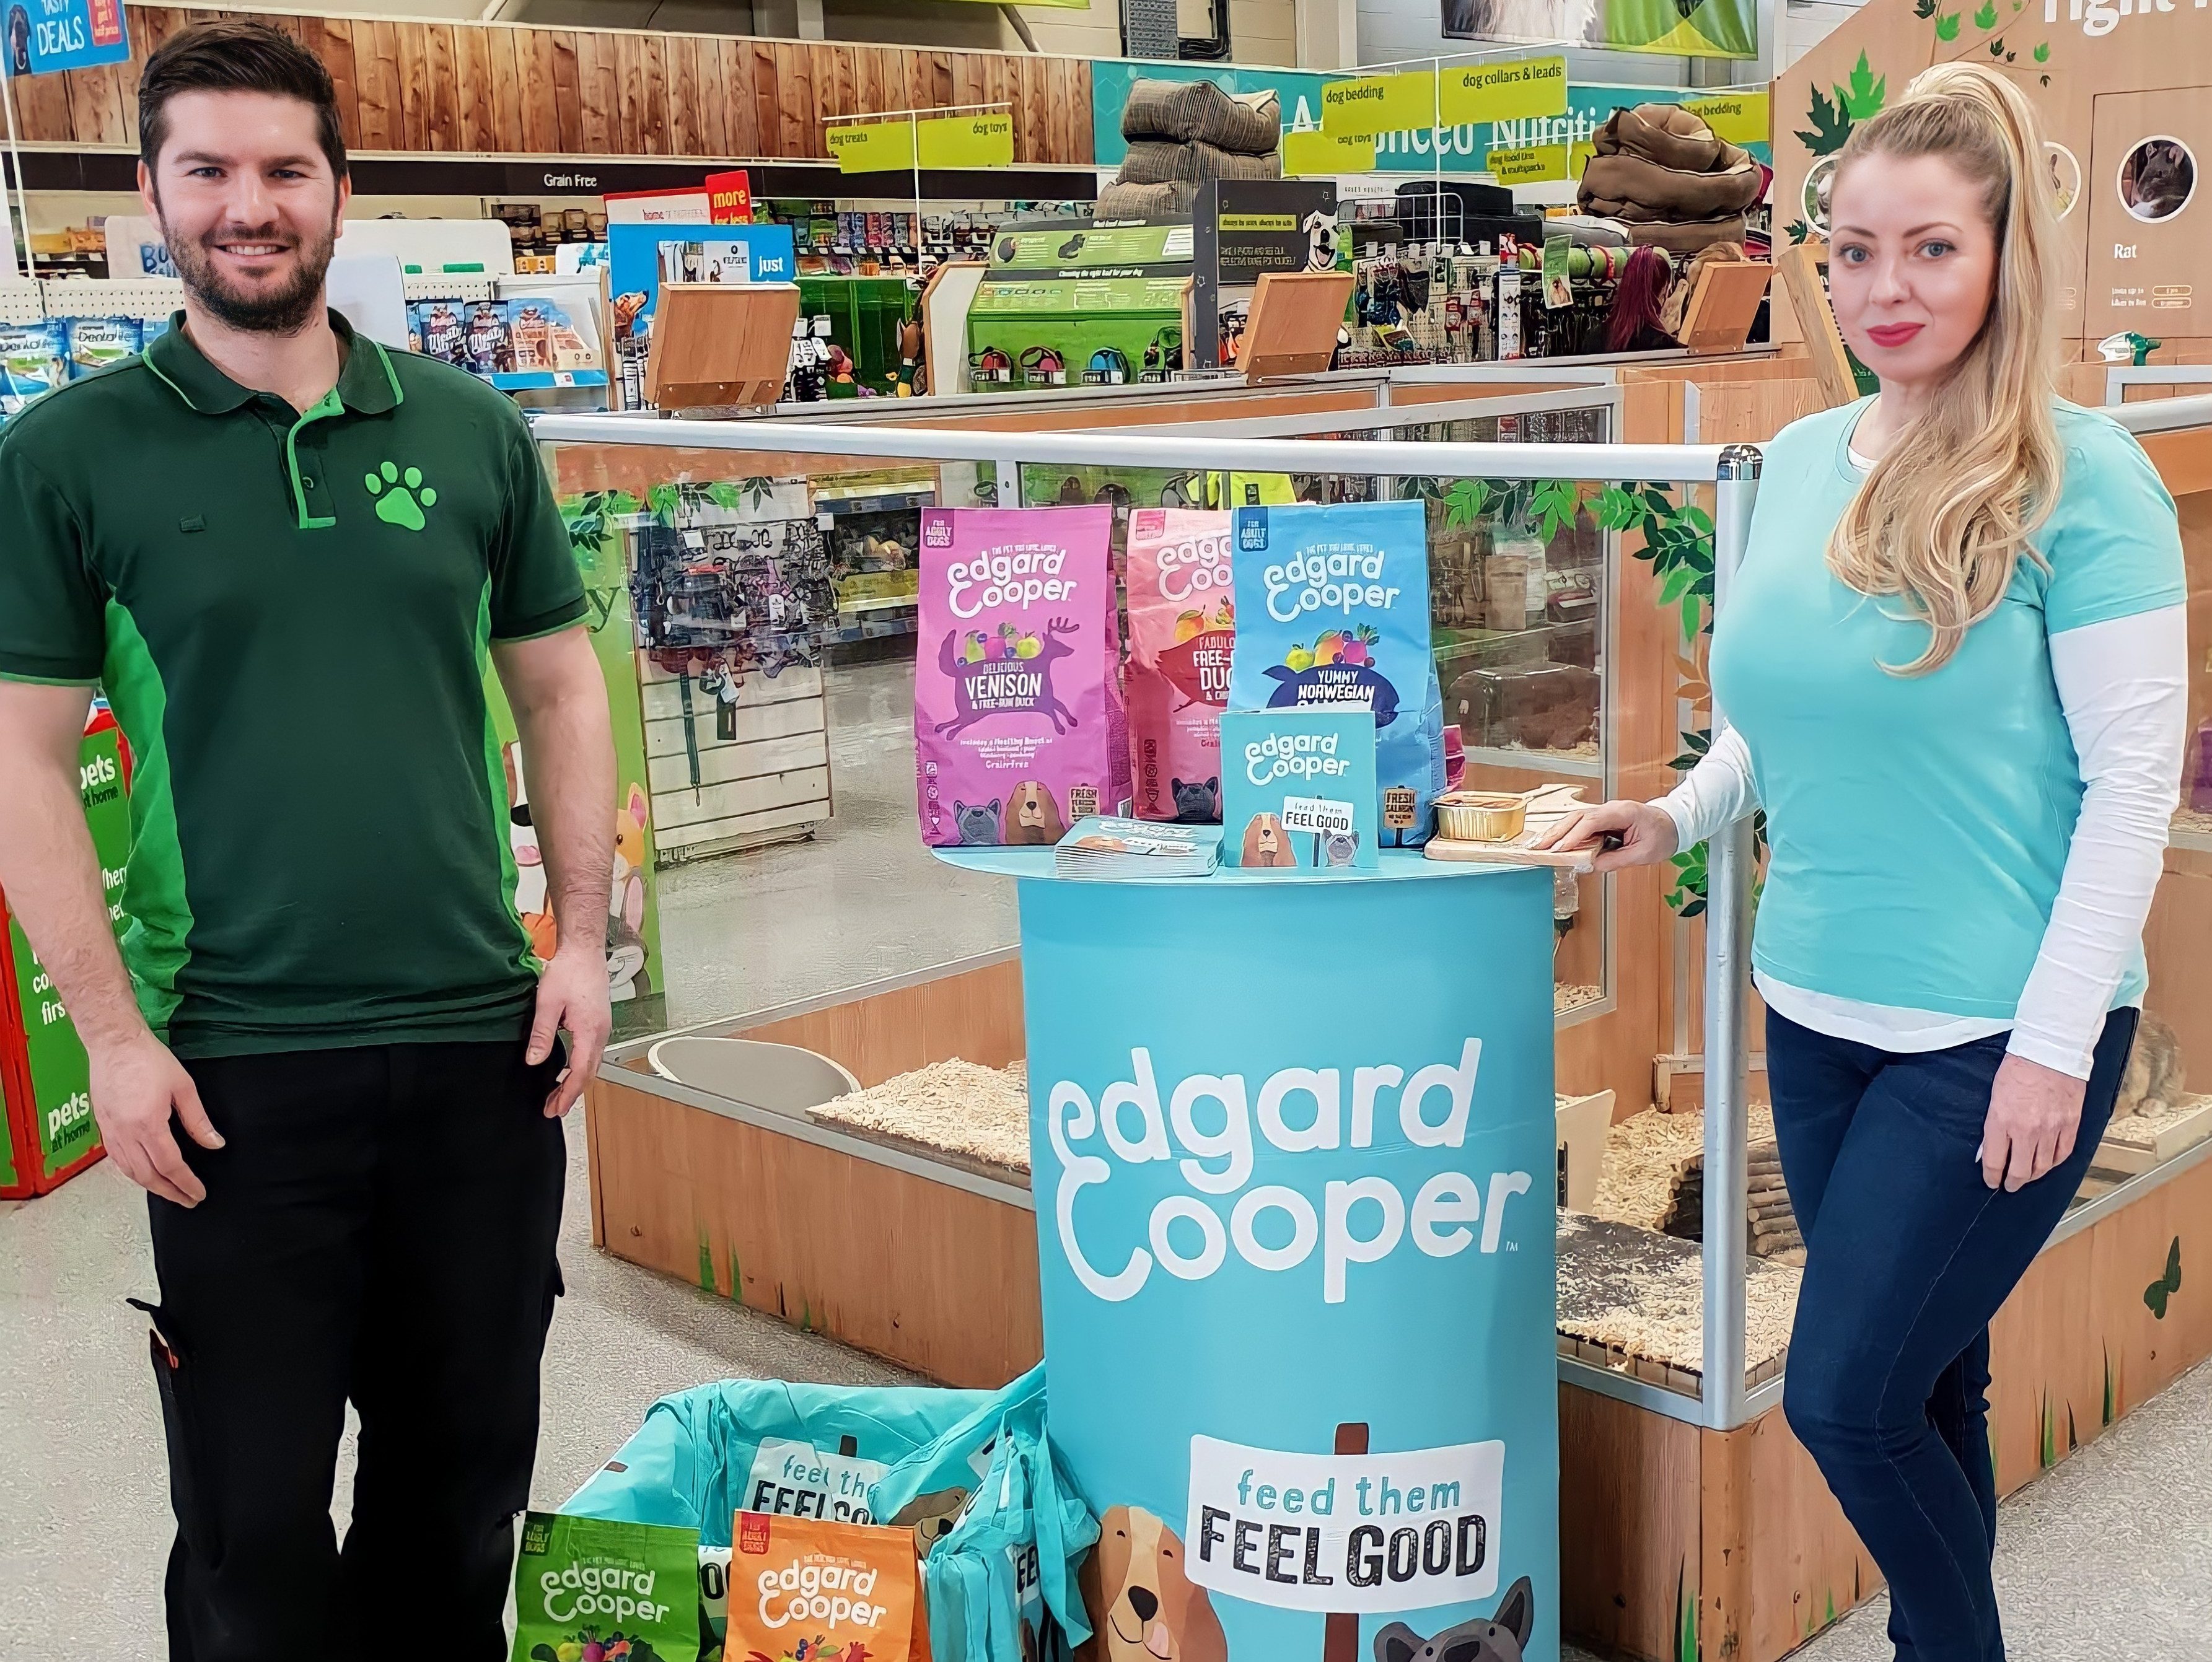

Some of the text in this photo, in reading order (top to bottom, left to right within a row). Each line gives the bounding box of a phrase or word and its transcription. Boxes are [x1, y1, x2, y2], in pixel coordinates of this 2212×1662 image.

[37, 16, 85, 56] DEALS
[1463, 64, 1561, 89] dog collars & leads
[1326, 85, 1384, 105] dog bedding
[830, 132, 845, 146] dog
[972, 121, 988, 136] dog
[543, 173, 597, 187] Grain Free
[713, 190, 747, 209] more
[2114, 243, 2137, 259] Rat
[758, 256, 784, 277] just
[947, 549, 1066, 587] edgard
[1263, 551, 1385, 588] edgard
[949, 579, 1077, 619] Cooper
[1266, 583, 1401, 623] Cooper
[983, 662, 1024, 675] DELICIOUS
[1318, 670, 1359, 684] YUMMY
[965, 673, 1042, 700] VENISON
[1298, 684, 1376, 701] NORWEGIAN
[1015, 697, 1035, 707] DUCK
[1244, 732, 1338, 760] edgard
[1247, 756, 1350, 786] Cooper
[1071, 789, 1097, 798] FRESH
[1387, 792, 1415, 804] FRESH
[1286, 811, 1349, 831] FEEL GOOD
[1319, 802, 1343, 815] them
[48, 1091, 90, 1141] pets
[1048, 1037, 1483, 1194] edgard
[1056, 1156, 1533, 1304] Cooper
[1237, 1468, 1462, 1516] feed them
[1200, 1504, 1486, 1588] FEEL GOOD
[540, 1560, 656, 1596] edgard
[758, 1559, 877, 1599] edgard
[543, 1589, 670, 1623] Cooper
[758, 1590, 887, 1629] Cooper
